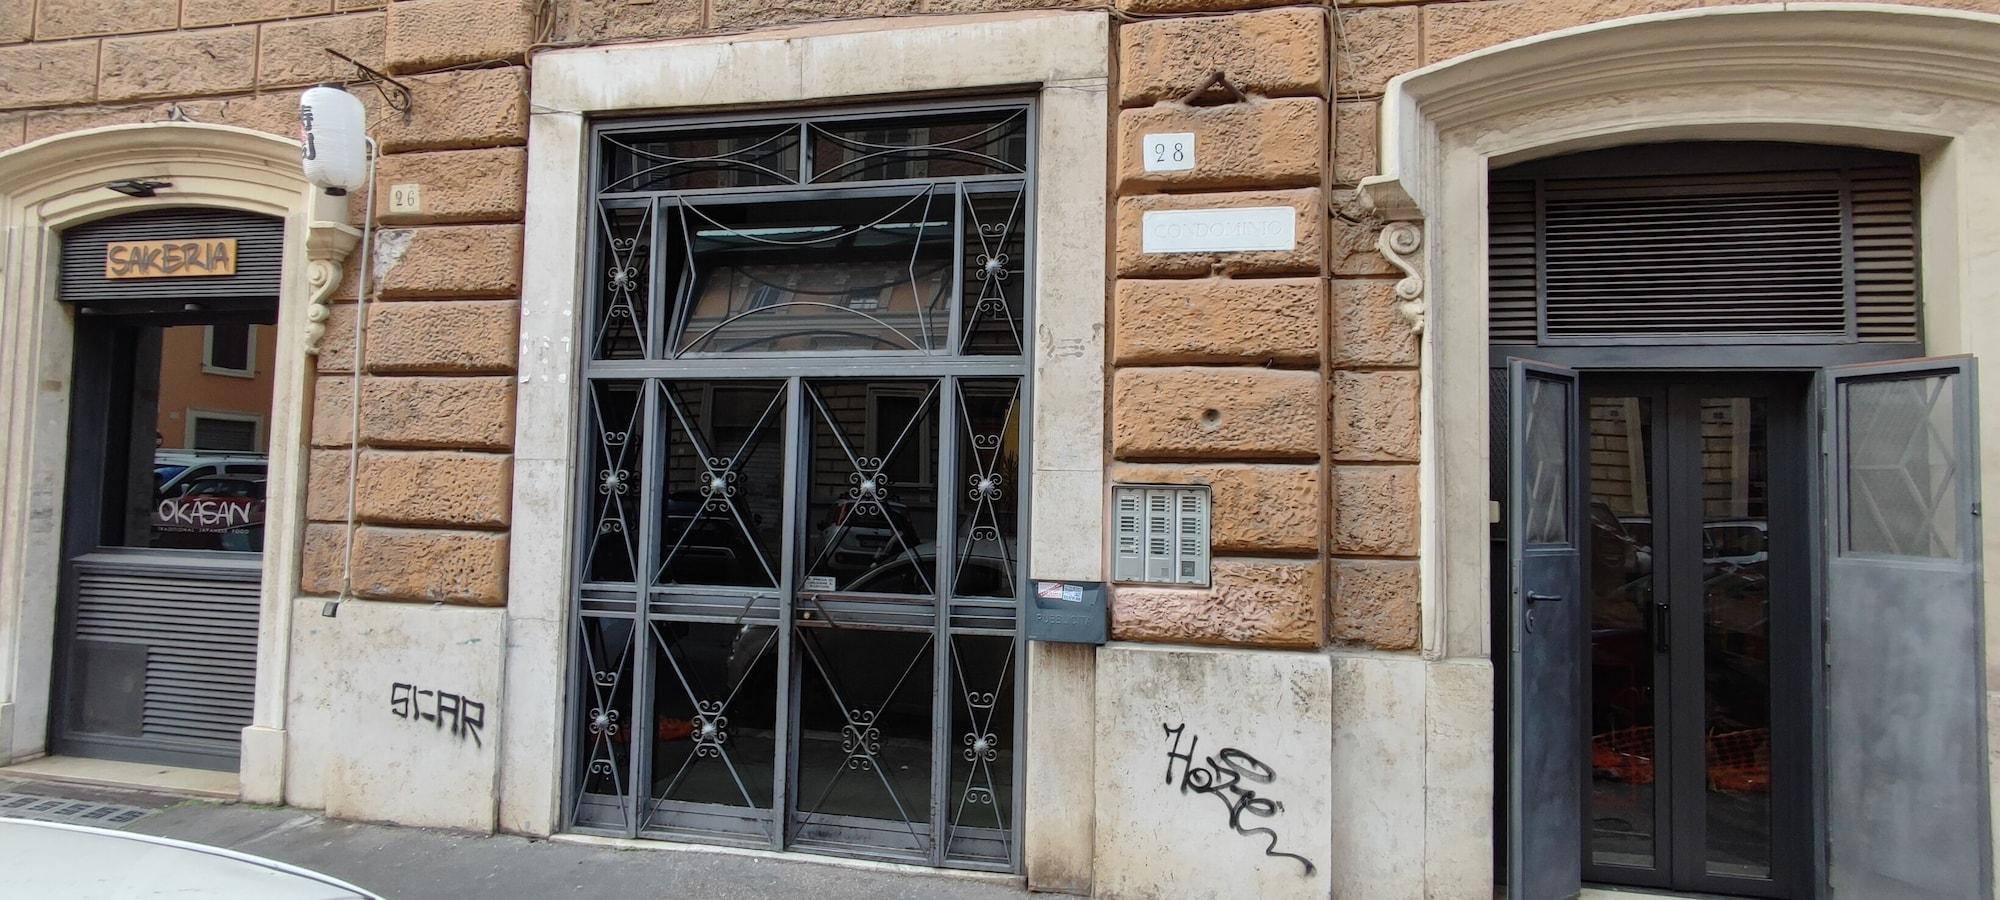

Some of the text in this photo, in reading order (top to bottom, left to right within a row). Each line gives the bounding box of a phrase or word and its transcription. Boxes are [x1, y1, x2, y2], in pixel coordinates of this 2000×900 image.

[1155, 142, 1184, 163] 28
[395, 190, 415, 206] 26
[1154, 219, 1283, 239] CONDOMINIO
[109, 242, 230, 276] SAKERIA
